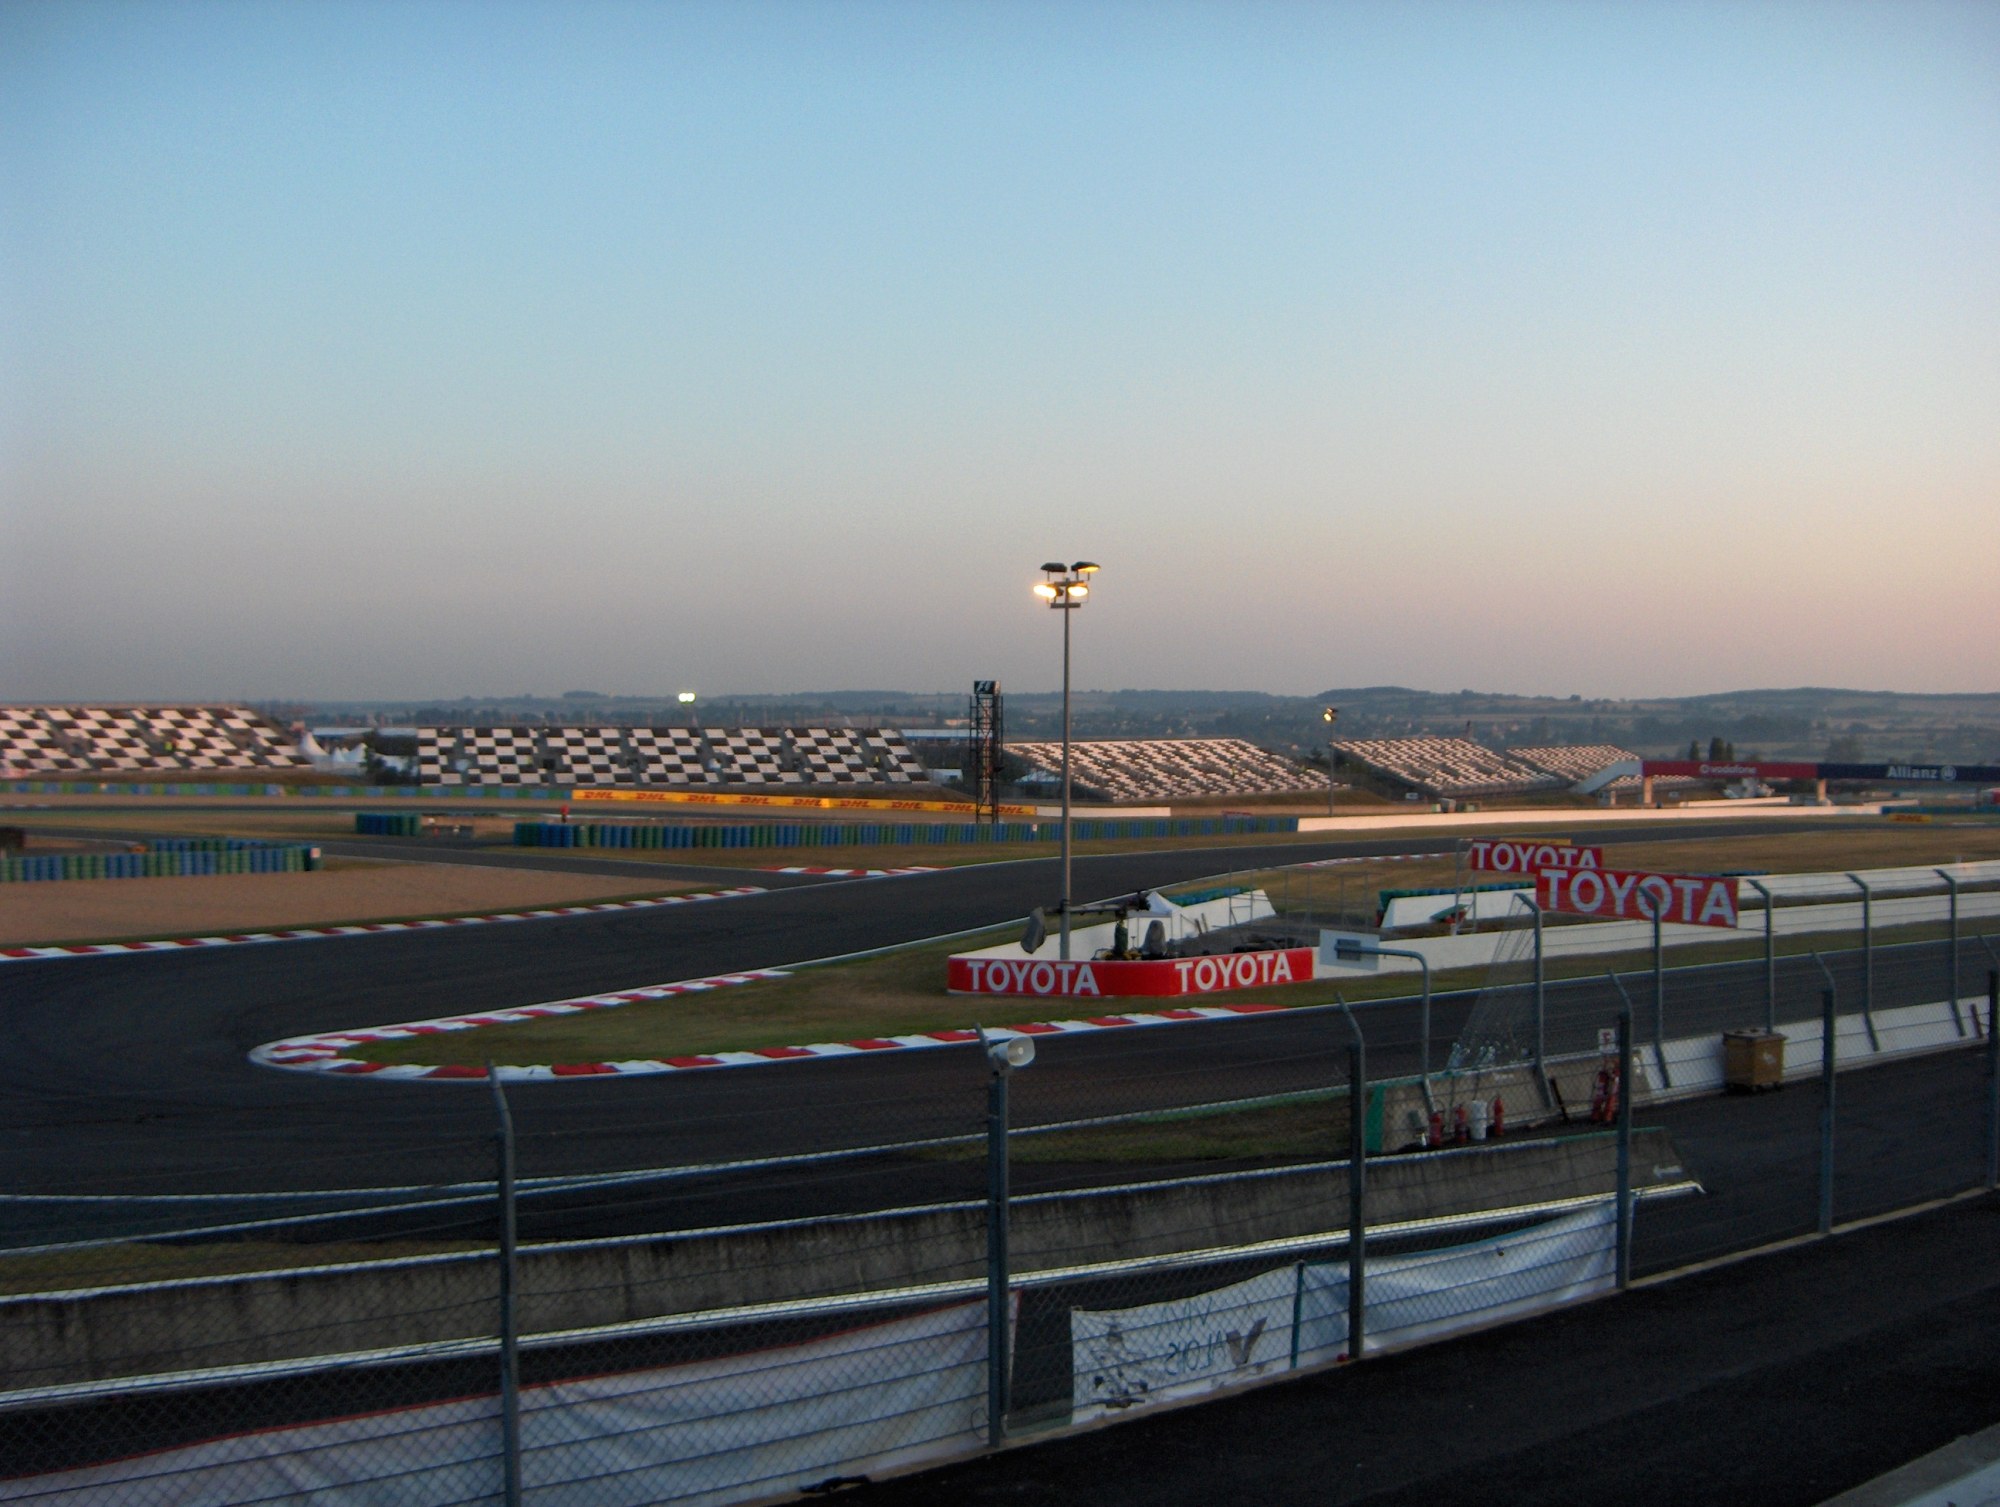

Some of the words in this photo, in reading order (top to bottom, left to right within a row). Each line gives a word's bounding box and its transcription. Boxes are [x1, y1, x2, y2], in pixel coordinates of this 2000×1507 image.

[1886, 766, 1938, 779] Allianz
[584, 791, 614, 799] DHL
[635, 792, 666, 800] DHL
[687, 794, 718, 803] DHL
[740, 796, 770, 804] DHL
[793, 798, 822, 807] DHL
[839, 800, 870, 808] DHL
[890, 801, 923, 809] DHL
[943, 803, 973, 811] DHL
[1472, 842, 1597, 871] TOYOTA
[1540, 869, 1737, 925] TOYOTA
[1174, 952, 1293, 993] TOYOTA
[966, 960, 1100, 996] TOYOTA
